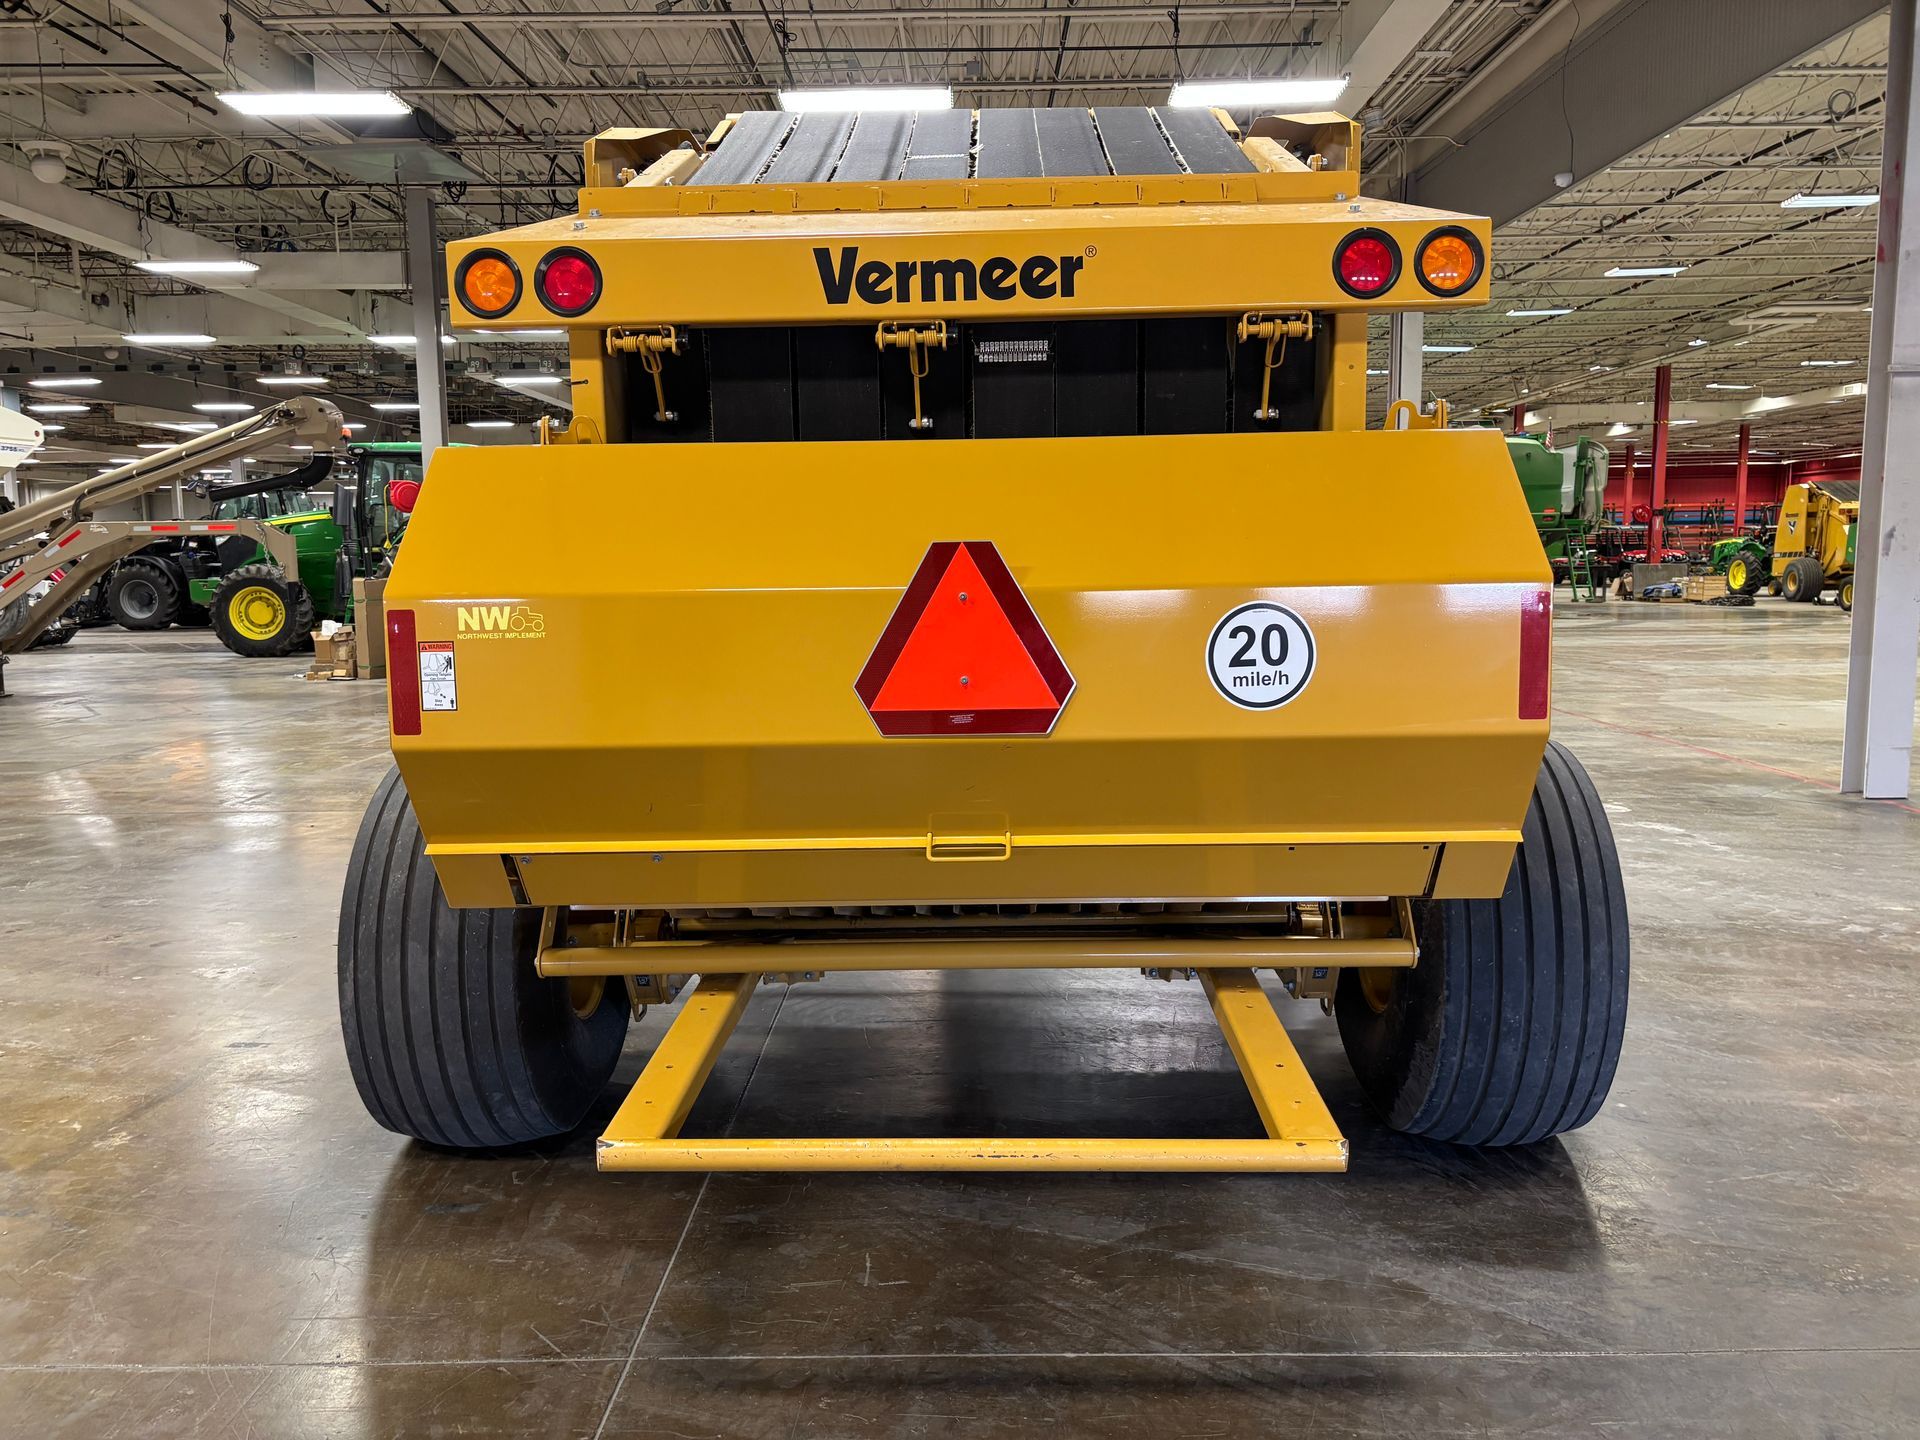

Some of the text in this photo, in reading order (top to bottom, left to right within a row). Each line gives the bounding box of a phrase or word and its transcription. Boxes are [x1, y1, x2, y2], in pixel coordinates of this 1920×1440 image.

[812, 246, 1084, 305] Vermeer
[457, 606, 511, 631] NW
[1228, 623, 1289, 668] 20
[1232, 670, 1289, 688] mile/h
